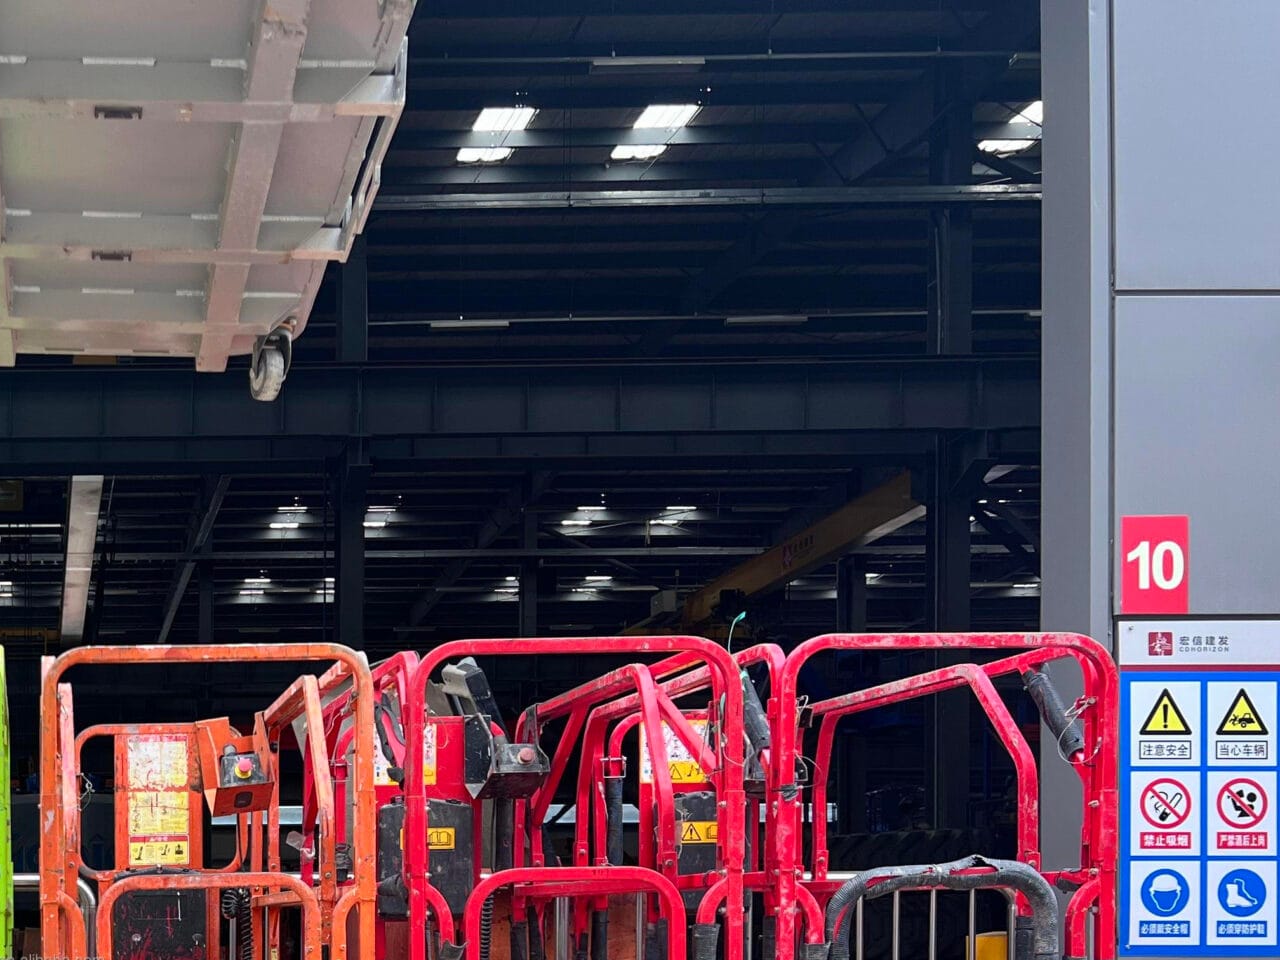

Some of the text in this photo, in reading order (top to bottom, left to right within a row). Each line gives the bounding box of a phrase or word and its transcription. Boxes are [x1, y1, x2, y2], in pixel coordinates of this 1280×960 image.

[1127, 540, 1185, 590] 10
[1179, 636, 1229, 646] 宏信建发
[1142, 744, 1189, 757] 注意安全
[1219, 744, 1265, 757] 当心车辆
[1143, 834, 1189, 847] 禁止吸烟
